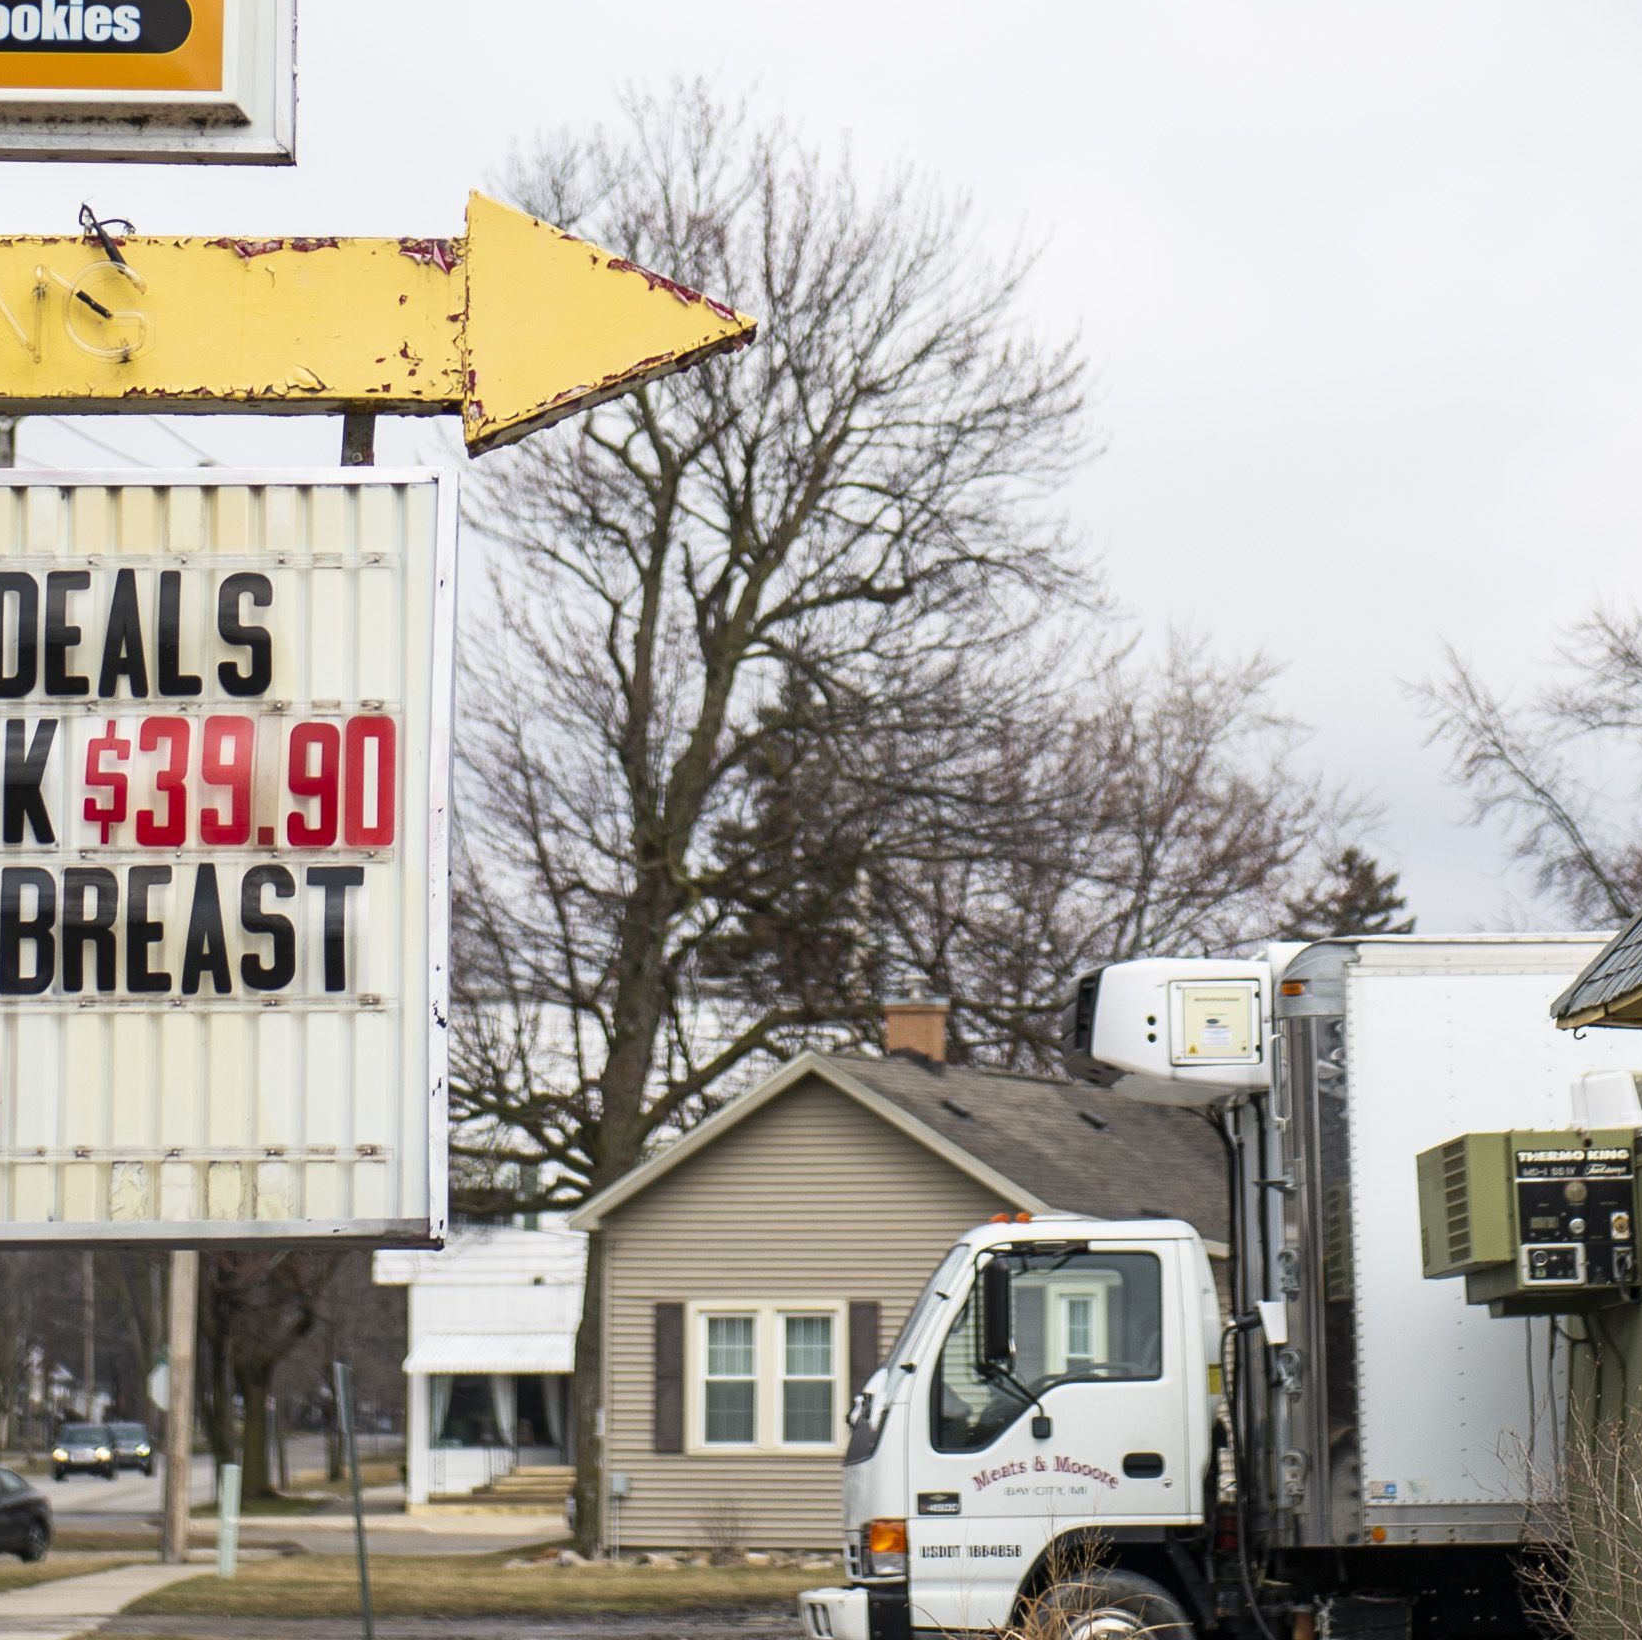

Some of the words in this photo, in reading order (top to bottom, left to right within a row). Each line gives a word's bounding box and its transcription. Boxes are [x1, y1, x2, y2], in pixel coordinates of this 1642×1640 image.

[83, 714, 397, 850] $39.90
[1587, 1149, 1630, 1160] KING
[971, 1460, 1028, 1491] Meats
[1032, 1455, 1048, 1472] &
[1053, 1455, 1120, 1489] Mooore
[921, 1544, 961, 1558] USDOT
